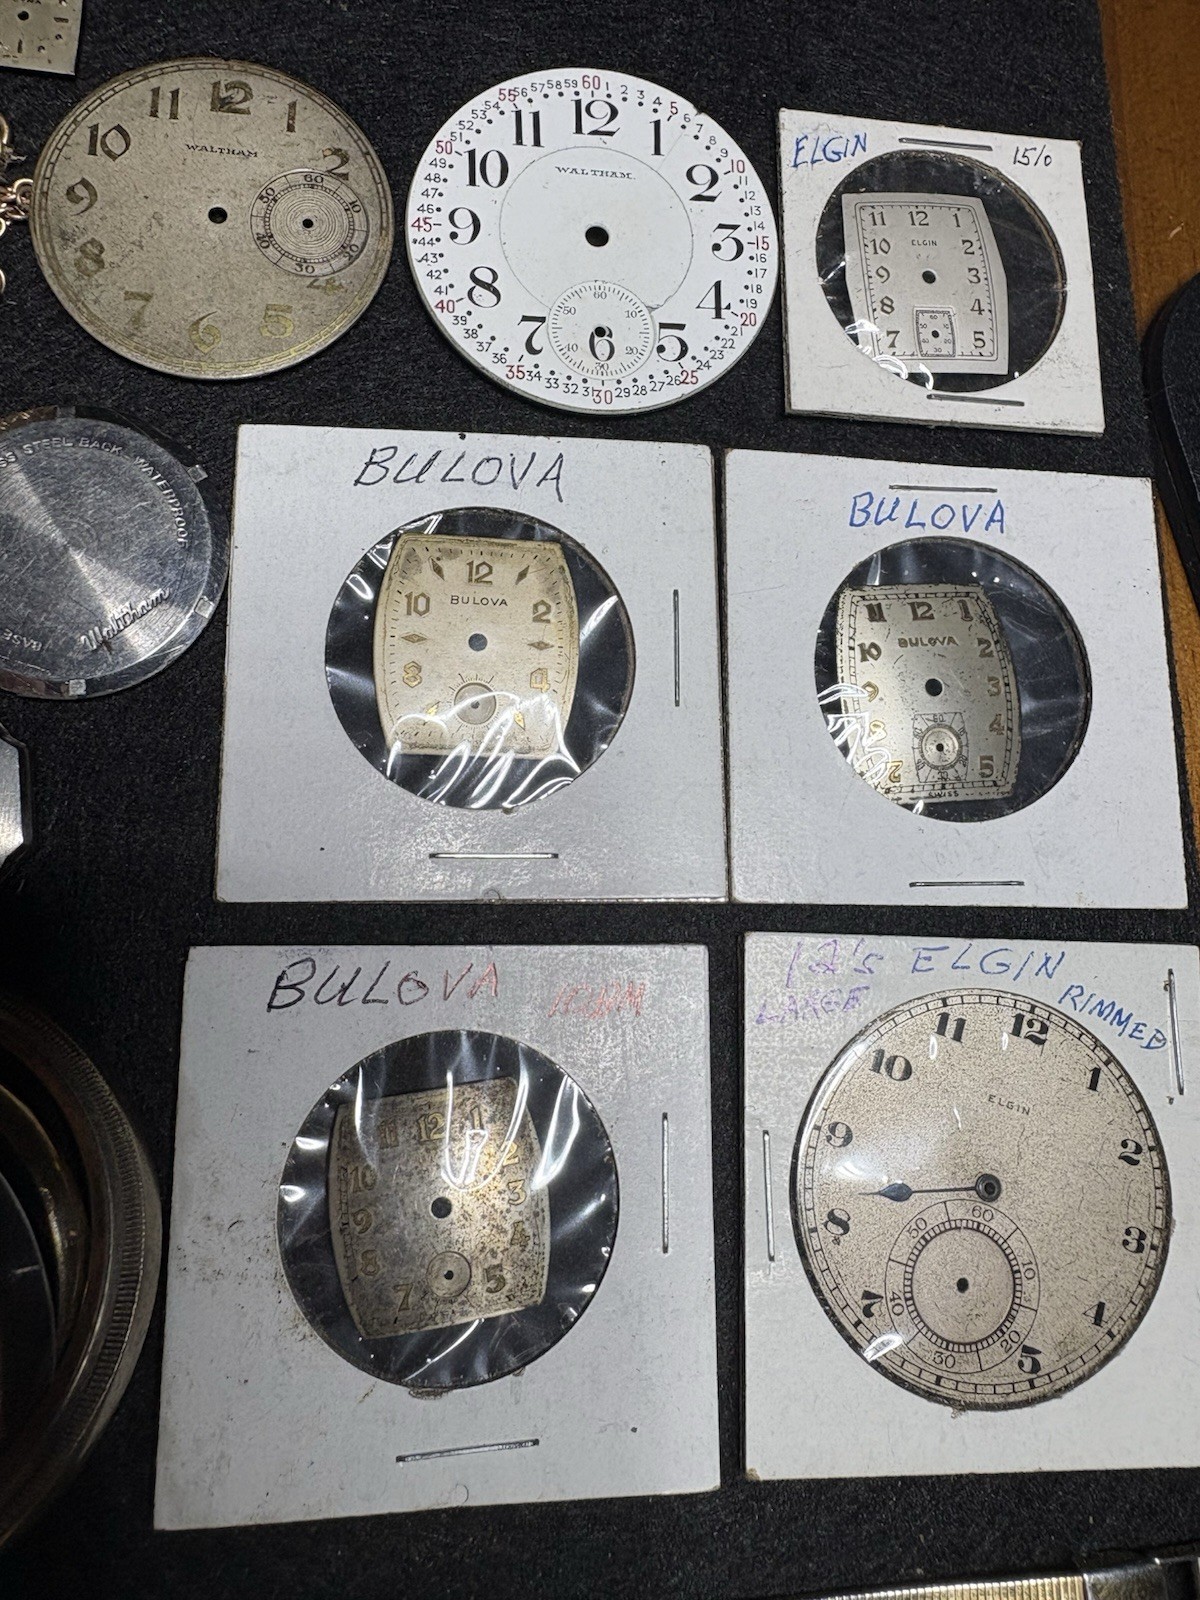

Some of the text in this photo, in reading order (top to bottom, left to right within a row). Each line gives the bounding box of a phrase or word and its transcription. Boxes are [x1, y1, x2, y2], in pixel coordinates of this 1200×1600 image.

[531, 82, 545, 92] 57
[547, 80, 562, 90] 58
[564, 79, 578, 88] 59
[582, 76, 600, 90] 60
[210, 80, 253, 116] 12
[498, 89, 516, 102] 55
[514, 86, 527, 97] 56
[638, 90, 644, 99] 3
[149, 86, 181, 120] 11
[484, 101, 500, 111] 54
[654, 97, 662, 105] 4
[670, 102, 678, 115] 5
[286, 100, 298, 133] 1
[471, 110, 487, 120] 53
[572, 98, 620, 136] 12
[684, 114, 690, 122] 6
[458, 121, 474, 130] 52
[511, 110, 544, 148] 11
[696, 124, 703, 132] 7
[88, 122, 131, 162] 10
[450, 132, 465, 141] 51
[650, 119, 664, 156] 1
[709, 136, 716, 145] 8
[185, 143, 258, 158] WALTHAM
[436, 141, 453, 154] 50
[720, 148, 728, 158] 9
[792, 132, 867, 168] ELGIN
[322, 146, 350, 181] 2
[429, 158, 447, 168] 49
[464, 148, 508, 188] 10
[730, 160, 745, 174] 10
[304, 174, 324, 184] 60
[424, 173, 442, 182] 48
[686, 164, 722, 202] 2
[740, 176, 748, 186] 11
[66, 178, 98, 216] 9
[421, 188, 438, 198] 47
[745, 191, 755, 200] 12
[417, 204, 434, 214] 46
[750, 206, 760, 215] 13
[411, 218, 432, 232] 45
[448, 207, 480, 245] 9
[753, 222, 765, 230] 14
[868, 212, 886, 226] 11
[908, 212, 930, 226] 12
[952, 214, 961, 228] 1
[418, 237, 436, 247] 44
[712, 223, 744, 261] 3
[756, 236, 769, 250] 15
[872, 238, 890, 254] 10
[962, 240, 974, 254] 2
[74, 238, 105, 278] 8
[421, 252, 438, 263] 43
[756, 253, 767, 263] 16
[294, 263, 316, 274] 30
[426, 269, 442, 280] 42
[755, 268, 767, 278] 17
[875, 266, 890, 284] 9
[968, 268, 980, 284] 3
[434, 286, 449, 296] 41
[468, 266, 501, 308] 8
[750, 284, 762, 294] 18
[434, 300, 455, 313] 40
[696, 280, 731, 319] 4
[746, 298, 757, 308] 19
[880, 296, 894, 314] 8
[970, 299, 984, 314] 4
[124, 291, 153, 326] 7
[260, 304, 294, 338] 5
[452, 315, 467, 326] 39
[740, 312, 757, 326] 20
[188, 312, 221, 354] 6
[463, 328, 478, 339] 38
[518, 315, 546, 355] 7
[731, 326, 743, 336] 21
[589, 326, 613, 361] 6
[656, 322, 688, 362] 5
[721, 338, 735, 349] 22
[886, 330, 900, 348] 7
[973, 331, 984, 348] 5
[476, 342, 492, 352] 37
[492, 353, 507, 364] 36
[710, 350, 724, 360] 23
[506, 365, 525, 379] 35
[696, 360, 711, 370] 24
[526, 370, 542, 381] 34
[545, 378, 559, 388] 33
[666, 375, 680, 386] 26
[680, 370, 698, 384] 25
[563, 383, 578, 394] 32
[582, 386, 594, 398] 31
[615, 387, 630, 398] 29
[633, 385, 648, 396] 28
[650, 381, 664, 392] 27
[592, 390, 613, 404] 30
[354, 445, 564, 502] BULOVA
[23, 437, 188, 548] STEEL BACK WATERPROOF
[849, 491, 1008, 534] BULOVA
[467, 560, 493, 585] 12
[404, 591, 430, 617] 10
[450, 594, 508, 607] BULOVA
[533, 600, 552, 623] 2
[865, 602, 886, 622] 11
[908, 602, 935, 621] 12
[960, 602, 974, 621] 1
[898, 635, 958, 647] BULOVA
[977, 638, 994, 658] 2
[857, 642, 881, 662] 10
[402, 660, 422, 688] 8
[530, 668, 550, 693] 4
[988, 676, 1001, 697] 3
[979, 756, 994, 778] 5
[912, 944, 1066, 980] ELGIN
[266, 957, 498, 1012] BULOVA
[1058, 984, 1167, 1050] RIMMED
[936, 1012, 966, 1042] 11
[1010, 1012, 1048, 1045] 12
[869, 1048, 912, 1081] 10
[1086, 1067, 1100, 1092] 1
[988, 1094, 1030, 1116] ELGIN
[826, 1121, 853, 1147] 9
[1118, 1138, 1142, 1166] 2
[972, 1206, 994, 1222] 60
[823, 1208, 850, 1236] 8
[908, 1218, 928, 1239] 50
[1122, 1226, 1146, 1254] 3
[1023, 1260, 1036, 1281] 10
[860, 1290, 883, 1318] 7
[890, 1291, 904, 1316] 40
[1083, 1301, 1106, 1330] 4
[1001, 1330, 1021, 1354] 20
[932, 1352, 956, 1369] 30
[1018, 1345, 1042, 1375] 5
